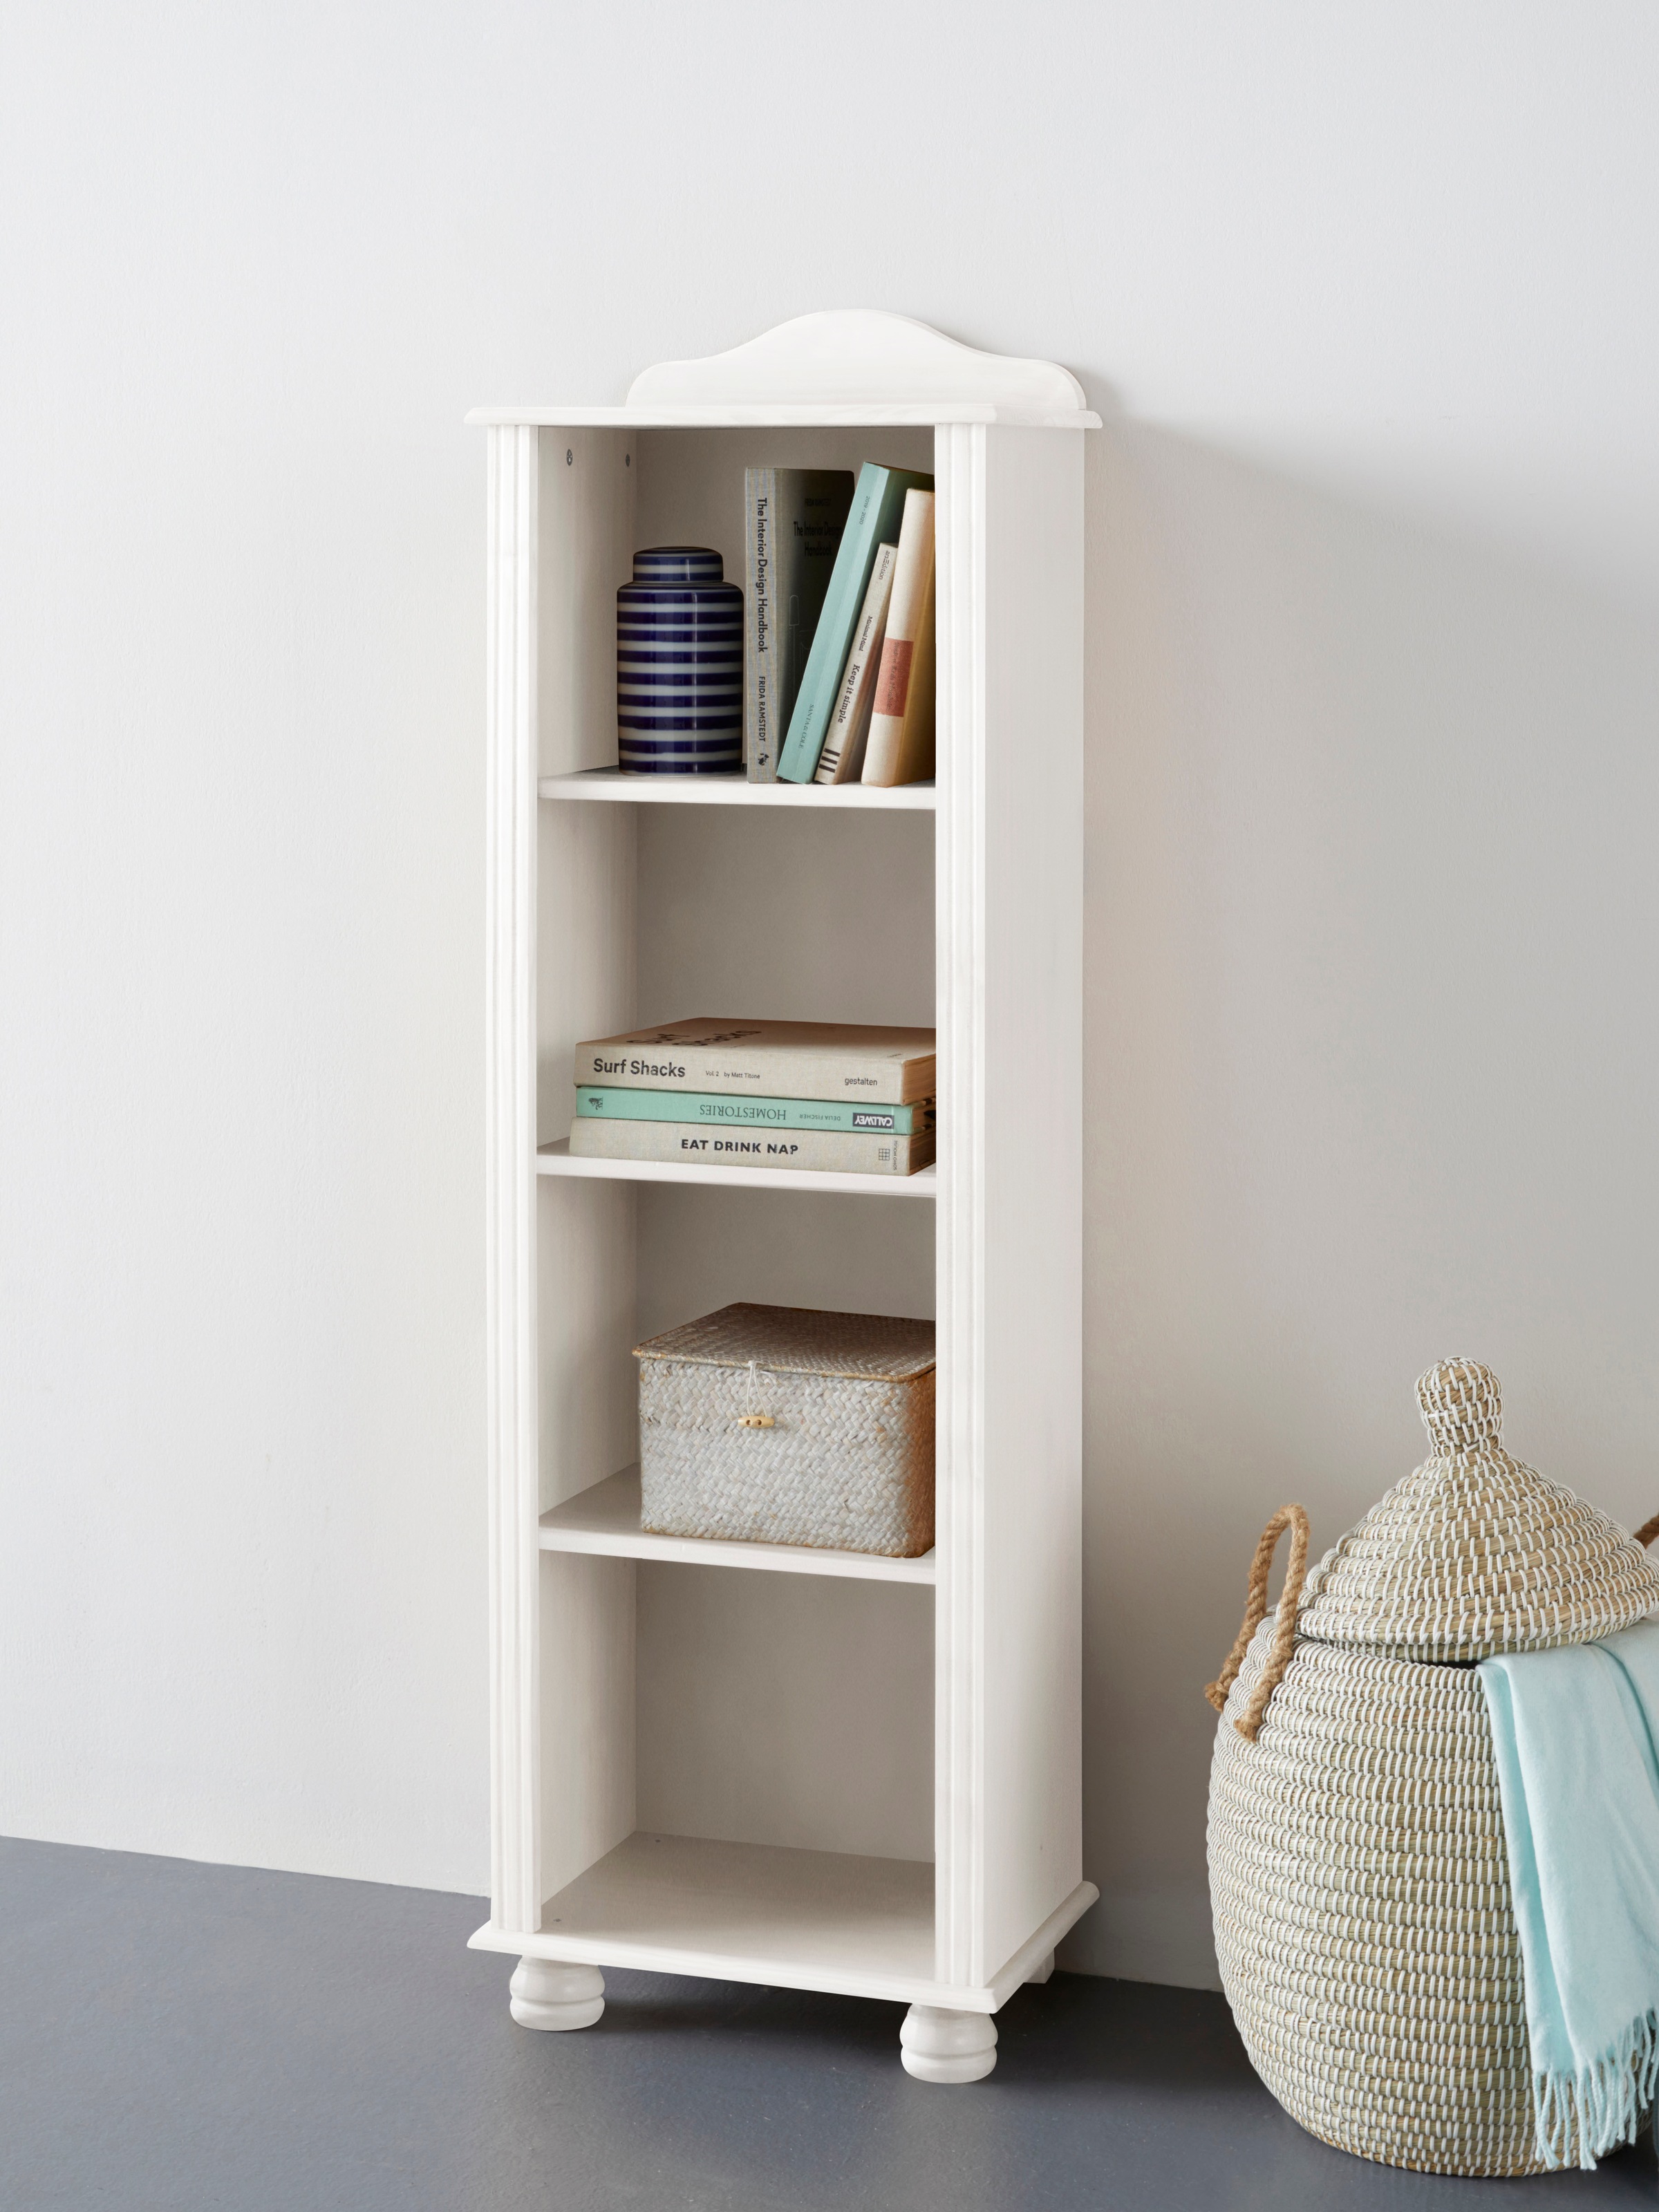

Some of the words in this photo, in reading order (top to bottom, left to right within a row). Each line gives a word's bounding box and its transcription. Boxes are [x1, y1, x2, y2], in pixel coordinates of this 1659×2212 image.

[758, 498, 767, 516] The
[758, 519, 767, 557] Interior
[794, 521, 803, 536] The
[804, 521, 824, 536] Interior
[756, 559, 768, 595] Design
[758, 599, 768, 653] Handbook
[863, 616, 873, 638] Minimal
[847, 664, 861, 686] Keep
[804, 704, 814, 725] SANTA
[838, 695, 851, 723] simple
[798, 732, 807, 749] COLE
[593, 1058, 626, 1074] Surf
[630, 1060, 686, 1078] Shacks
[845, 1077, 878, 1086] gestalten
[700, 1104, 787, 1121] HOMESTORIES
[854, 1114, 892, 1127] CALLWEY
[681, 1139, 709, 1150] EAT
[714, 1141, 762, 1153] DRINK
[767, 1143, 799, 1154] NAP
